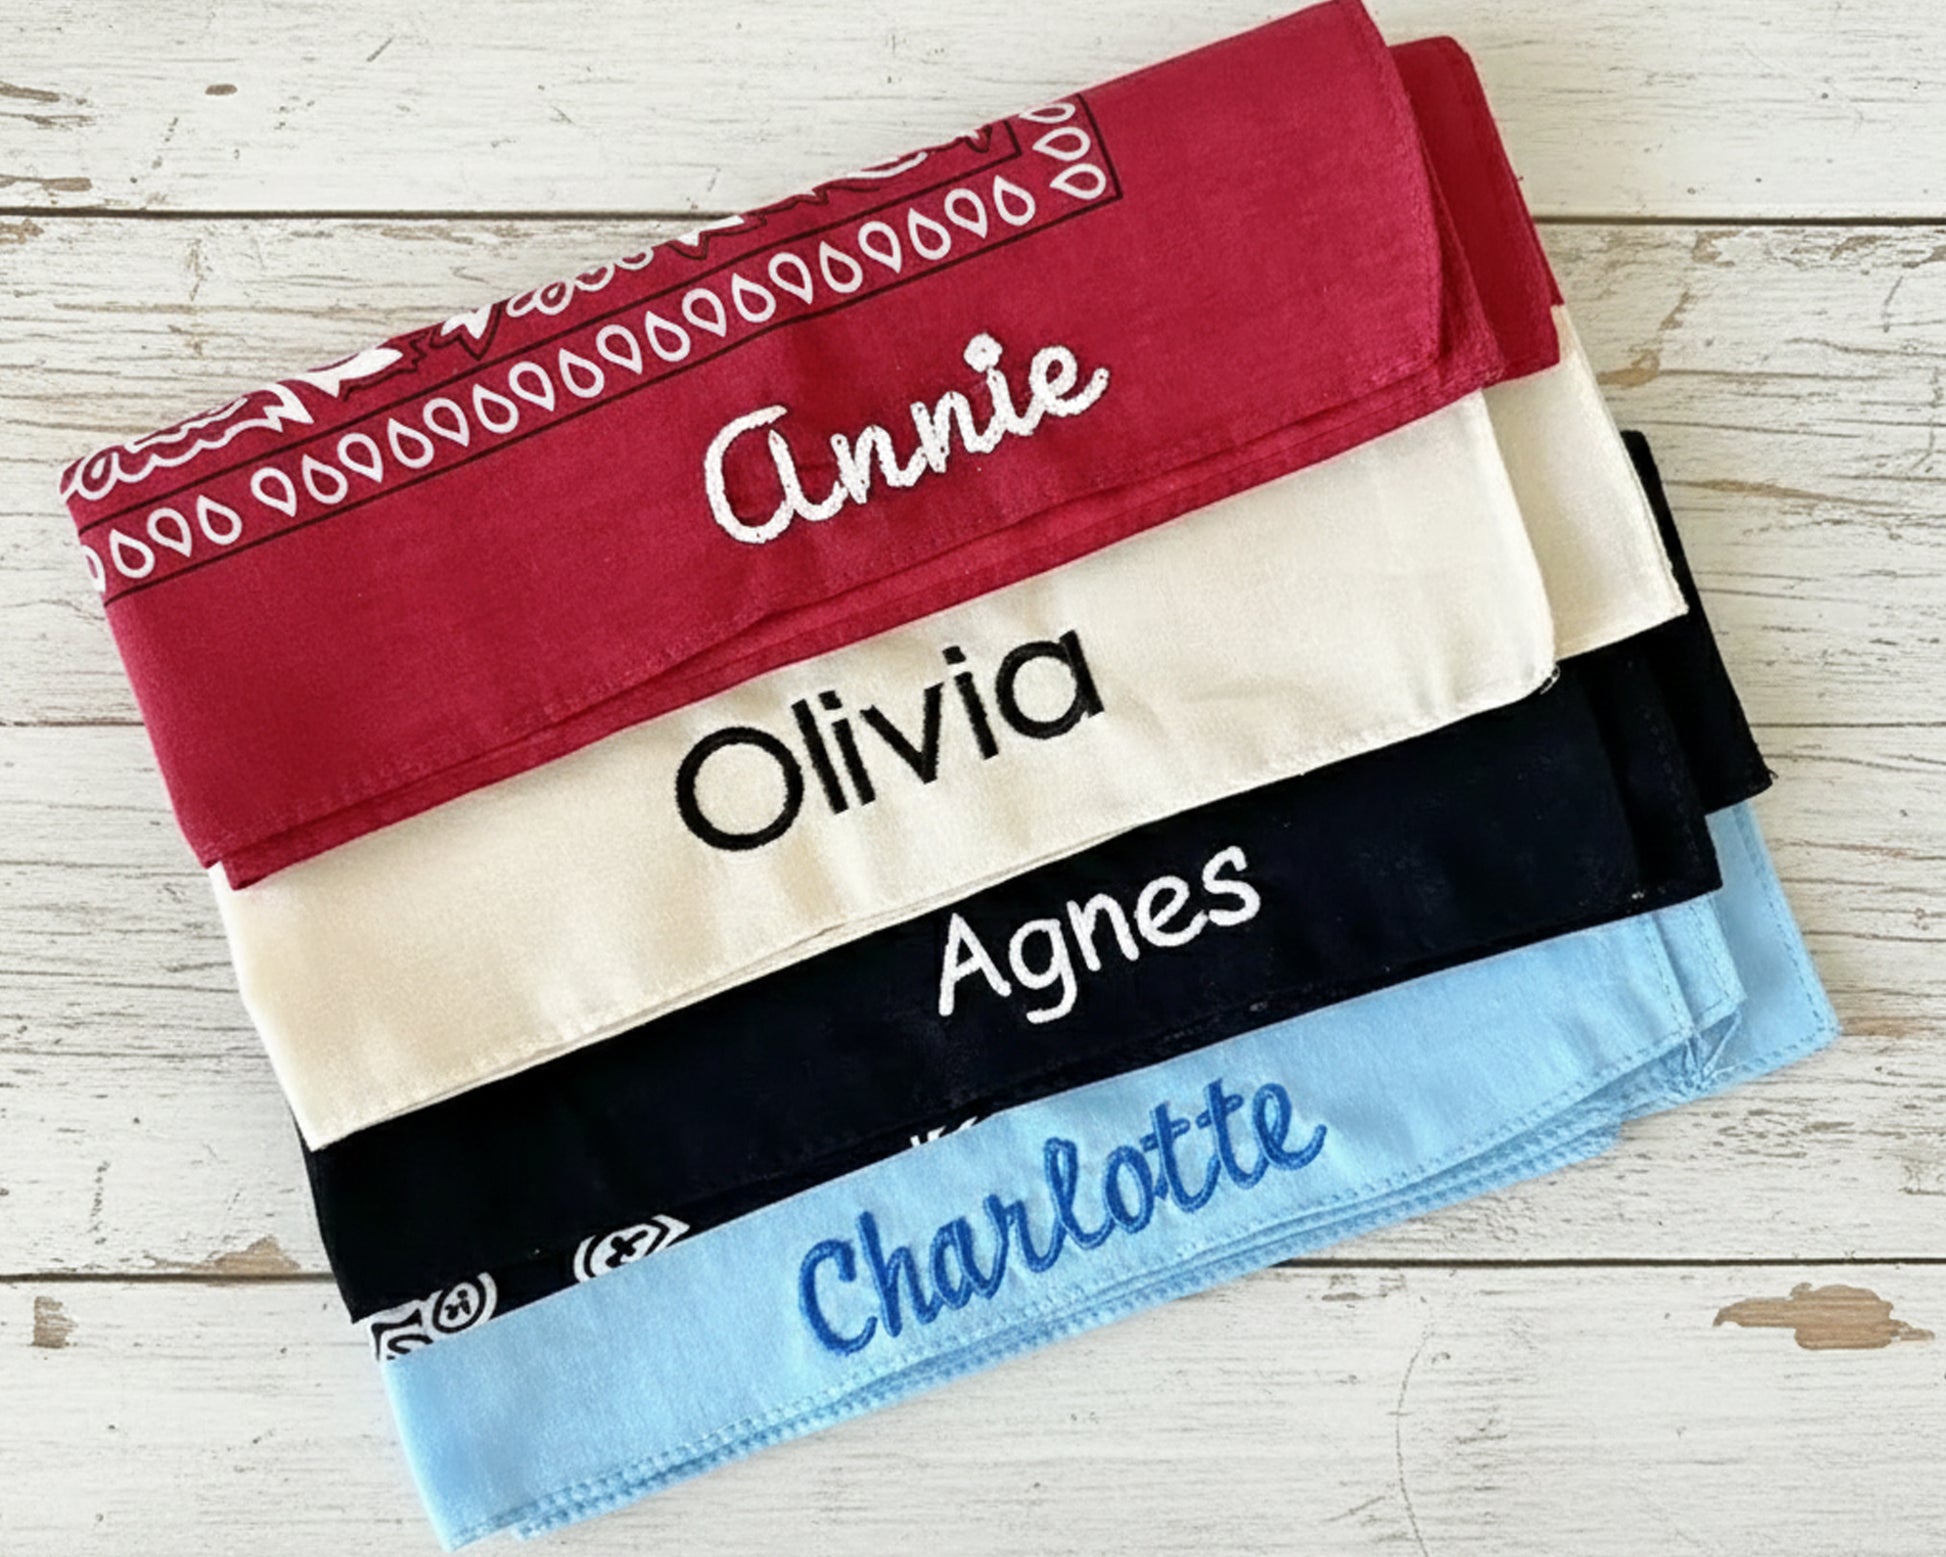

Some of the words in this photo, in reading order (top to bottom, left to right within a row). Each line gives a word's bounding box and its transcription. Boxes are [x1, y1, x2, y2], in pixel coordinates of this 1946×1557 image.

[704, 332, 1110, 545] Annie
[675, 629, 1105, 852] Olivia
[938, 845, 1261, 1024] Agnes
[798, 1077, 1328, 1357] Charlotte
